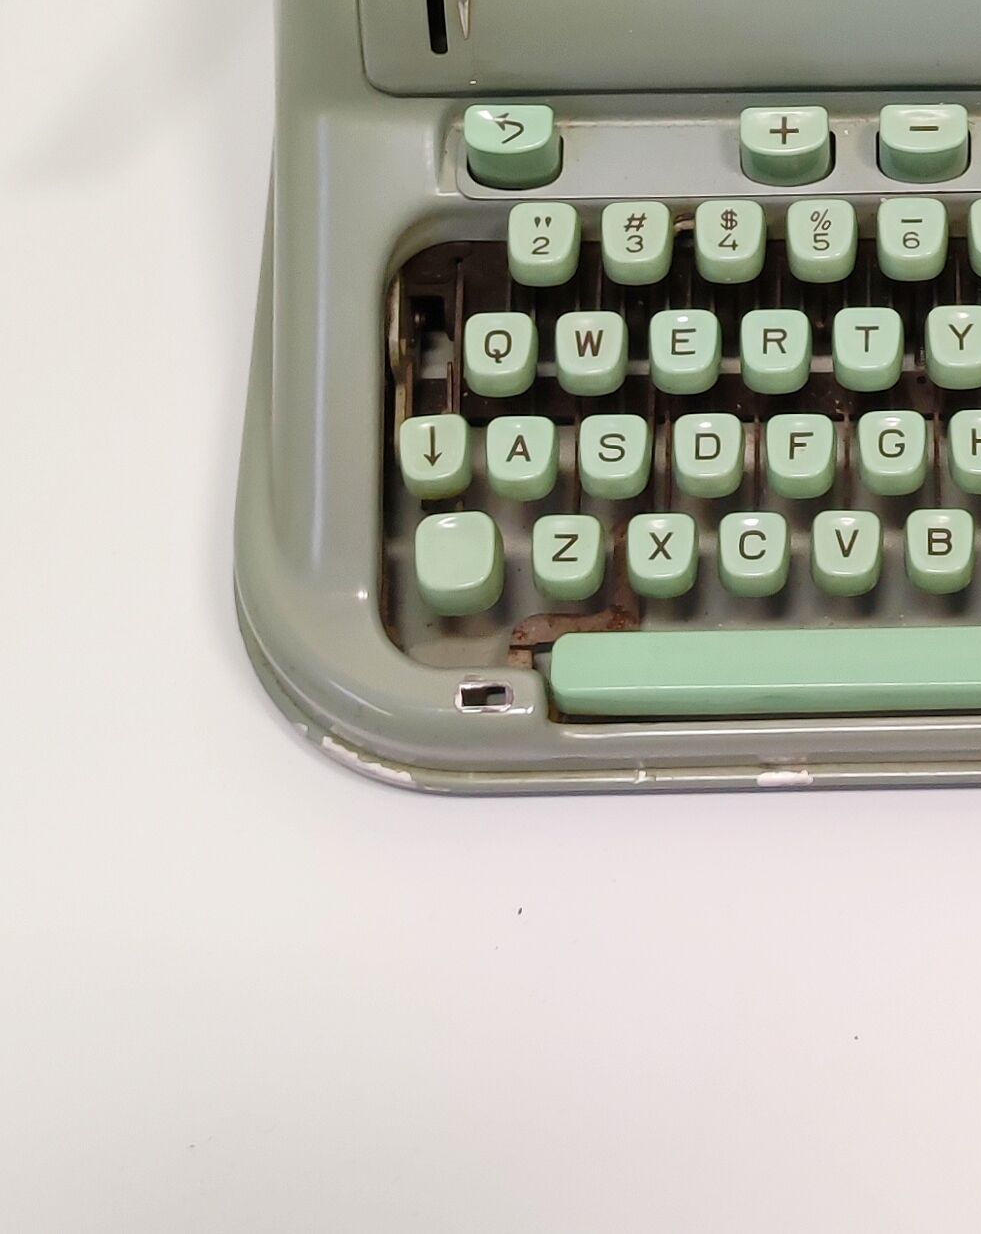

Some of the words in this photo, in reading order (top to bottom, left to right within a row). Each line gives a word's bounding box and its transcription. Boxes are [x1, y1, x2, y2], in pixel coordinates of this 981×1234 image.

[623, 212, 647, 233] #
[720, 209, 738, 231] $
[810, 208, 832, 232] %
[531, 236, 550, 255] 2
[625, 234, 644, 254] 3
[717, 233, 739, 251] 4
[812, 232, 830, 251] 5
[902, 231, 921, 250] 6
[484, 329, 513, 364] Q
[575, 329, 604, 358] W
[670, 328, 697, 356] E
[762, 328, 788, 355] R
[854, 325, 880, 353] T
[948, 323, 974, 351] Y
[505, 434, 532, 463] A
[598, 433, 626, 463] S
[694, 432, 721, 461] D
[789, 431, 814, 461] F
[878, 428, 906, 459] G
[551, 533, 579, 562] Z
[648, 531, 673, 561] X
[738, 529, 767, 561] C
[834, 529, 859, 558] V
[927, 527, 953, 556] B
